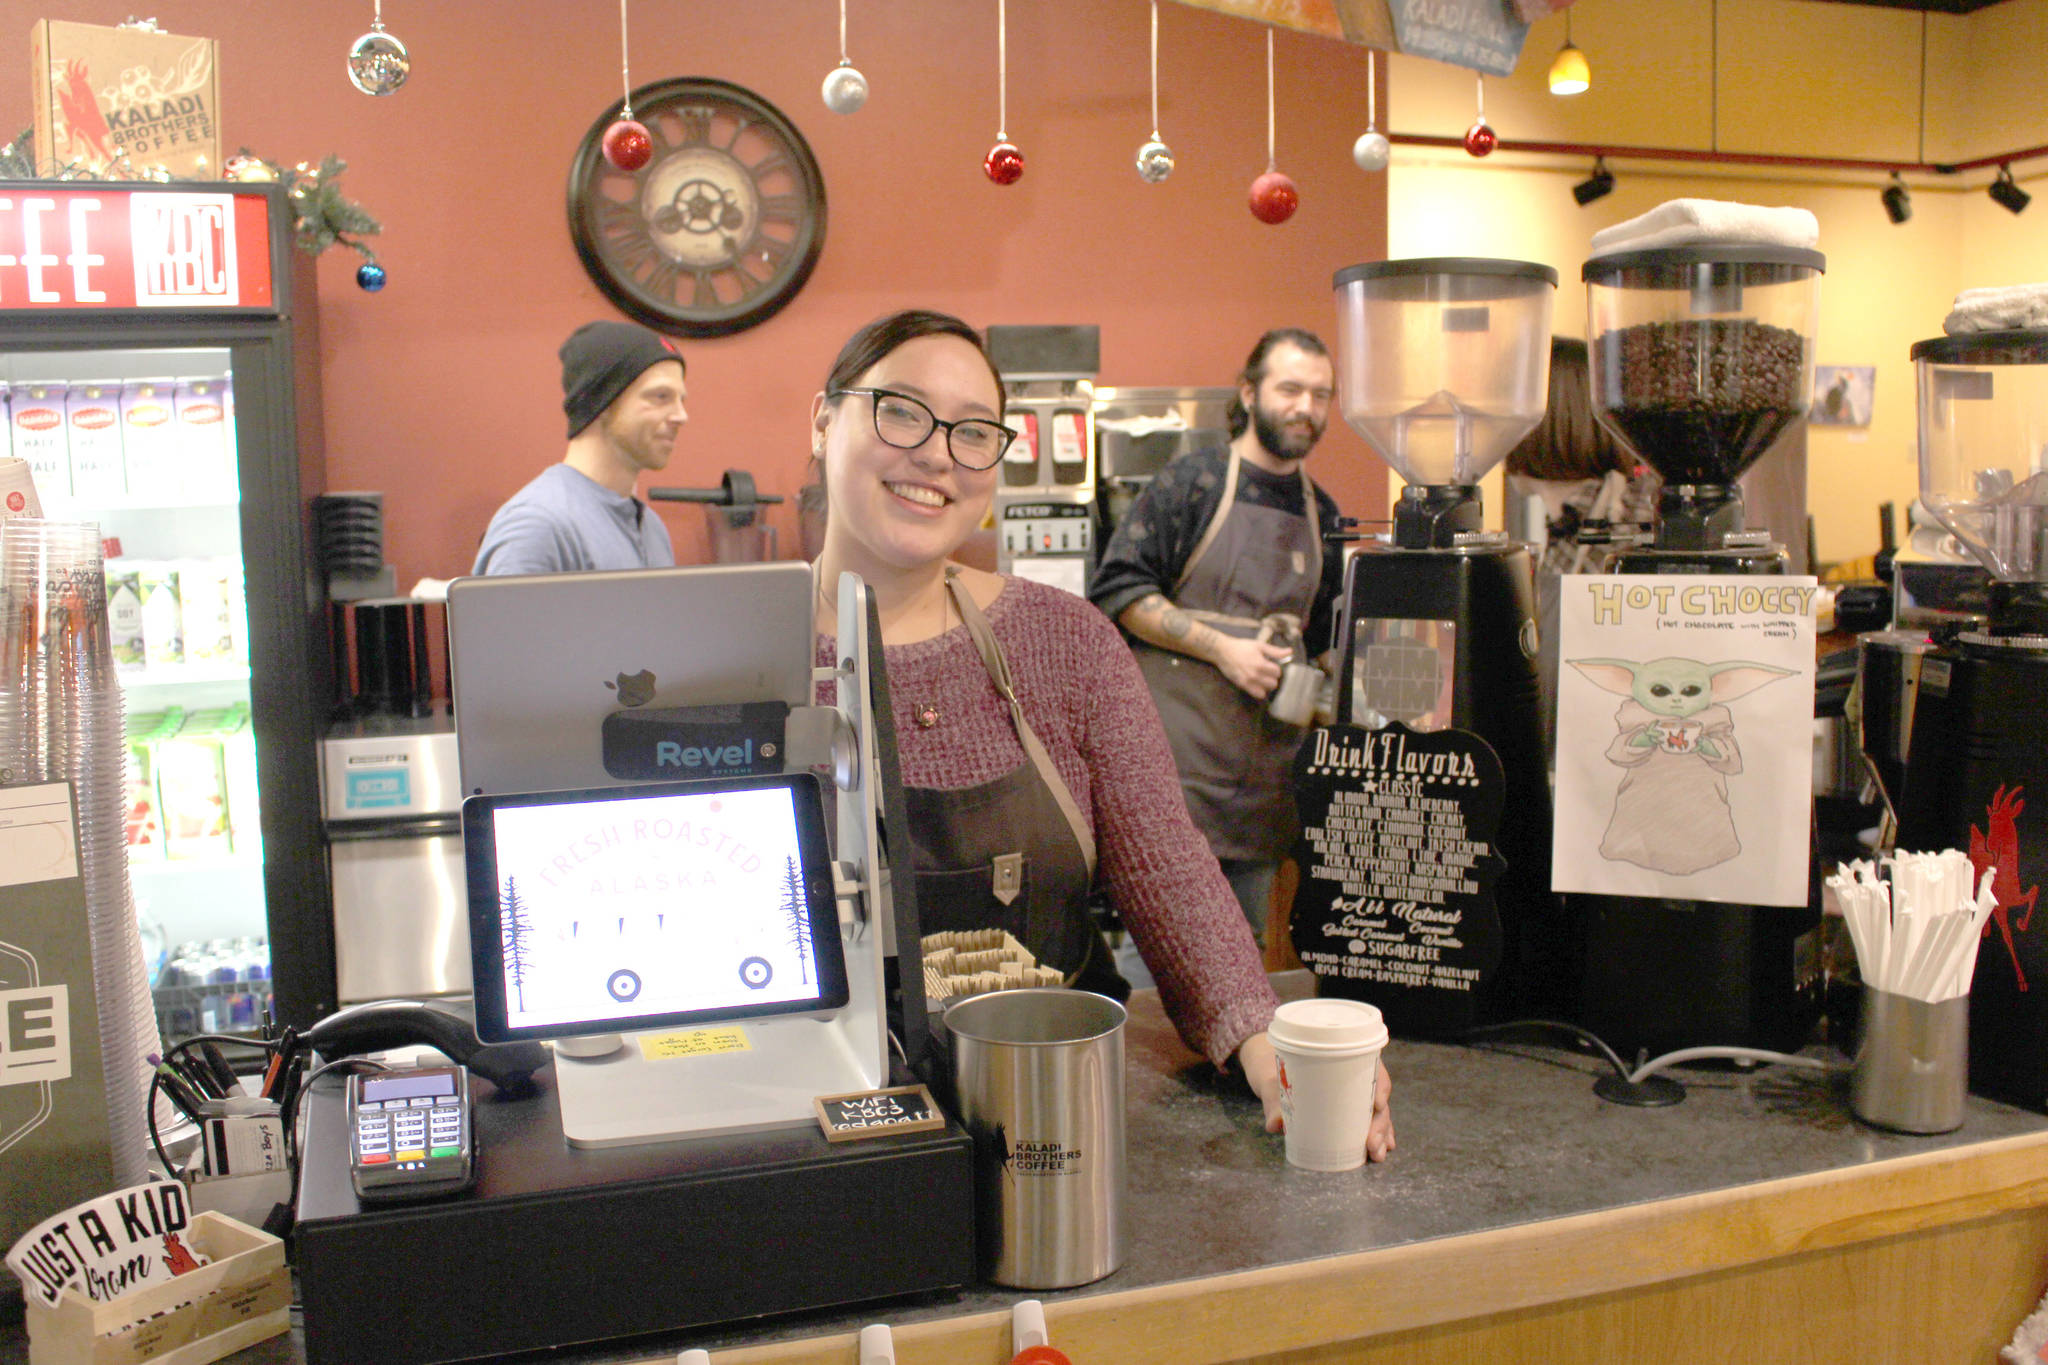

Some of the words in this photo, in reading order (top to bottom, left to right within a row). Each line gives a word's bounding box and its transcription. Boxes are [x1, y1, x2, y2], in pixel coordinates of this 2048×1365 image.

[105, 94, 204, 131] KALADI
[112, 112, 209, 145] BROTHERS
[148, 204, 227, 295] KBC
[1588, 583, 1676, 625] HOT
[1680, 584, 1817, 616] CHOCCY
[656, 738, 753, 767] Revel
[1314, 728, 1376, 770] Drink
[1380, 733, 1476, 778] Flavors
[1378, 778, 1424, 798] CLASSIC
[538, 825, 621, 888] FRESH
[633, 817, 761, 875] ROASTED
[590, 870, 717, 897] ALASKA
[1342, 897, 1385, 916] All
[1391, 902, 1462, 924] Natural
[1314, 964, 1339, 977] IRISH
[0, 996, 56, 1053] E
[841, 1104, 904, 1121] KBC3
[1016, 1143, 1062, 1152] KALADI
[1016, 1150, 1082, 1160] BROTHERS
[1016, 1160, 1065, 1170] COFFEE
[21, 1222, 87, 1303] JUST
[78, 1208, 118, 1258] A
[115, 1184, 188, 1243] KID
[81, 1252, 152, 1302] from
